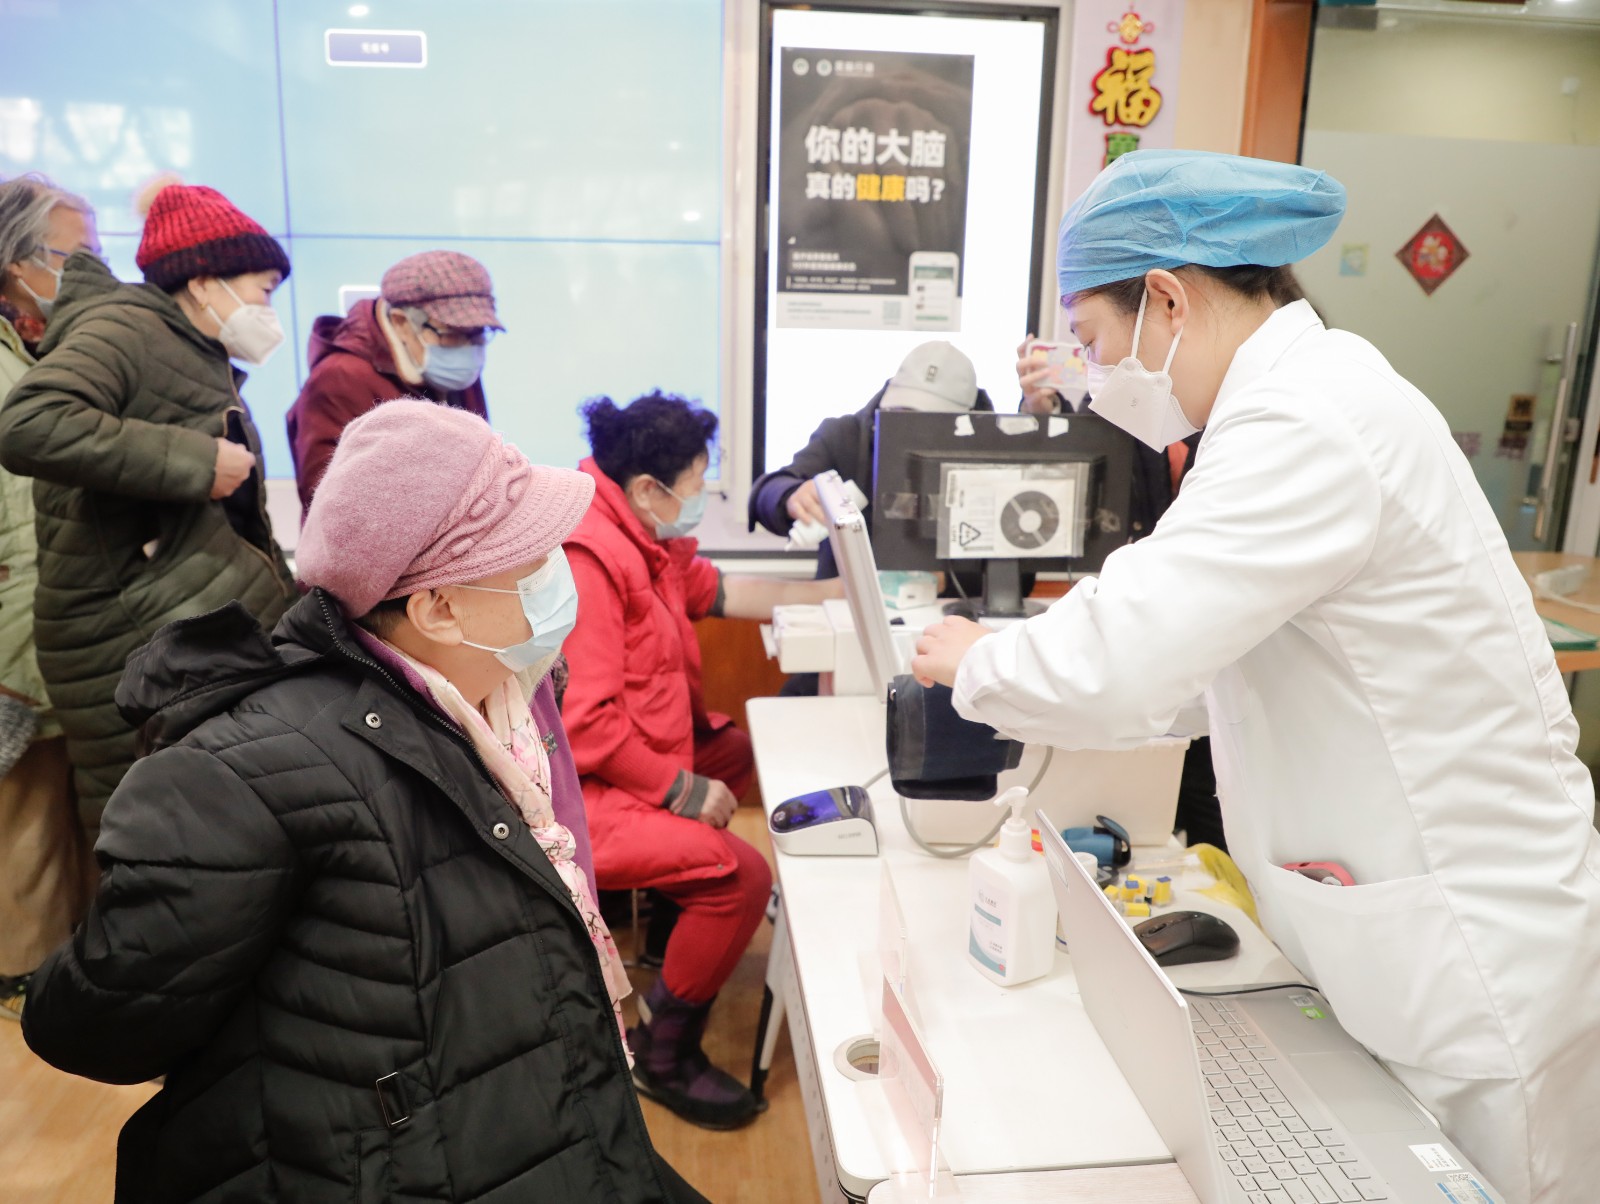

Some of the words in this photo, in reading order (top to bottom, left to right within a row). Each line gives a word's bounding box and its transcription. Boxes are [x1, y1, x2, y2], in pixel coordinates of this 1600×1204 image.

[1090, 47, 1162, 127] 福
[805, 125, 946, 167] 你的大脑
